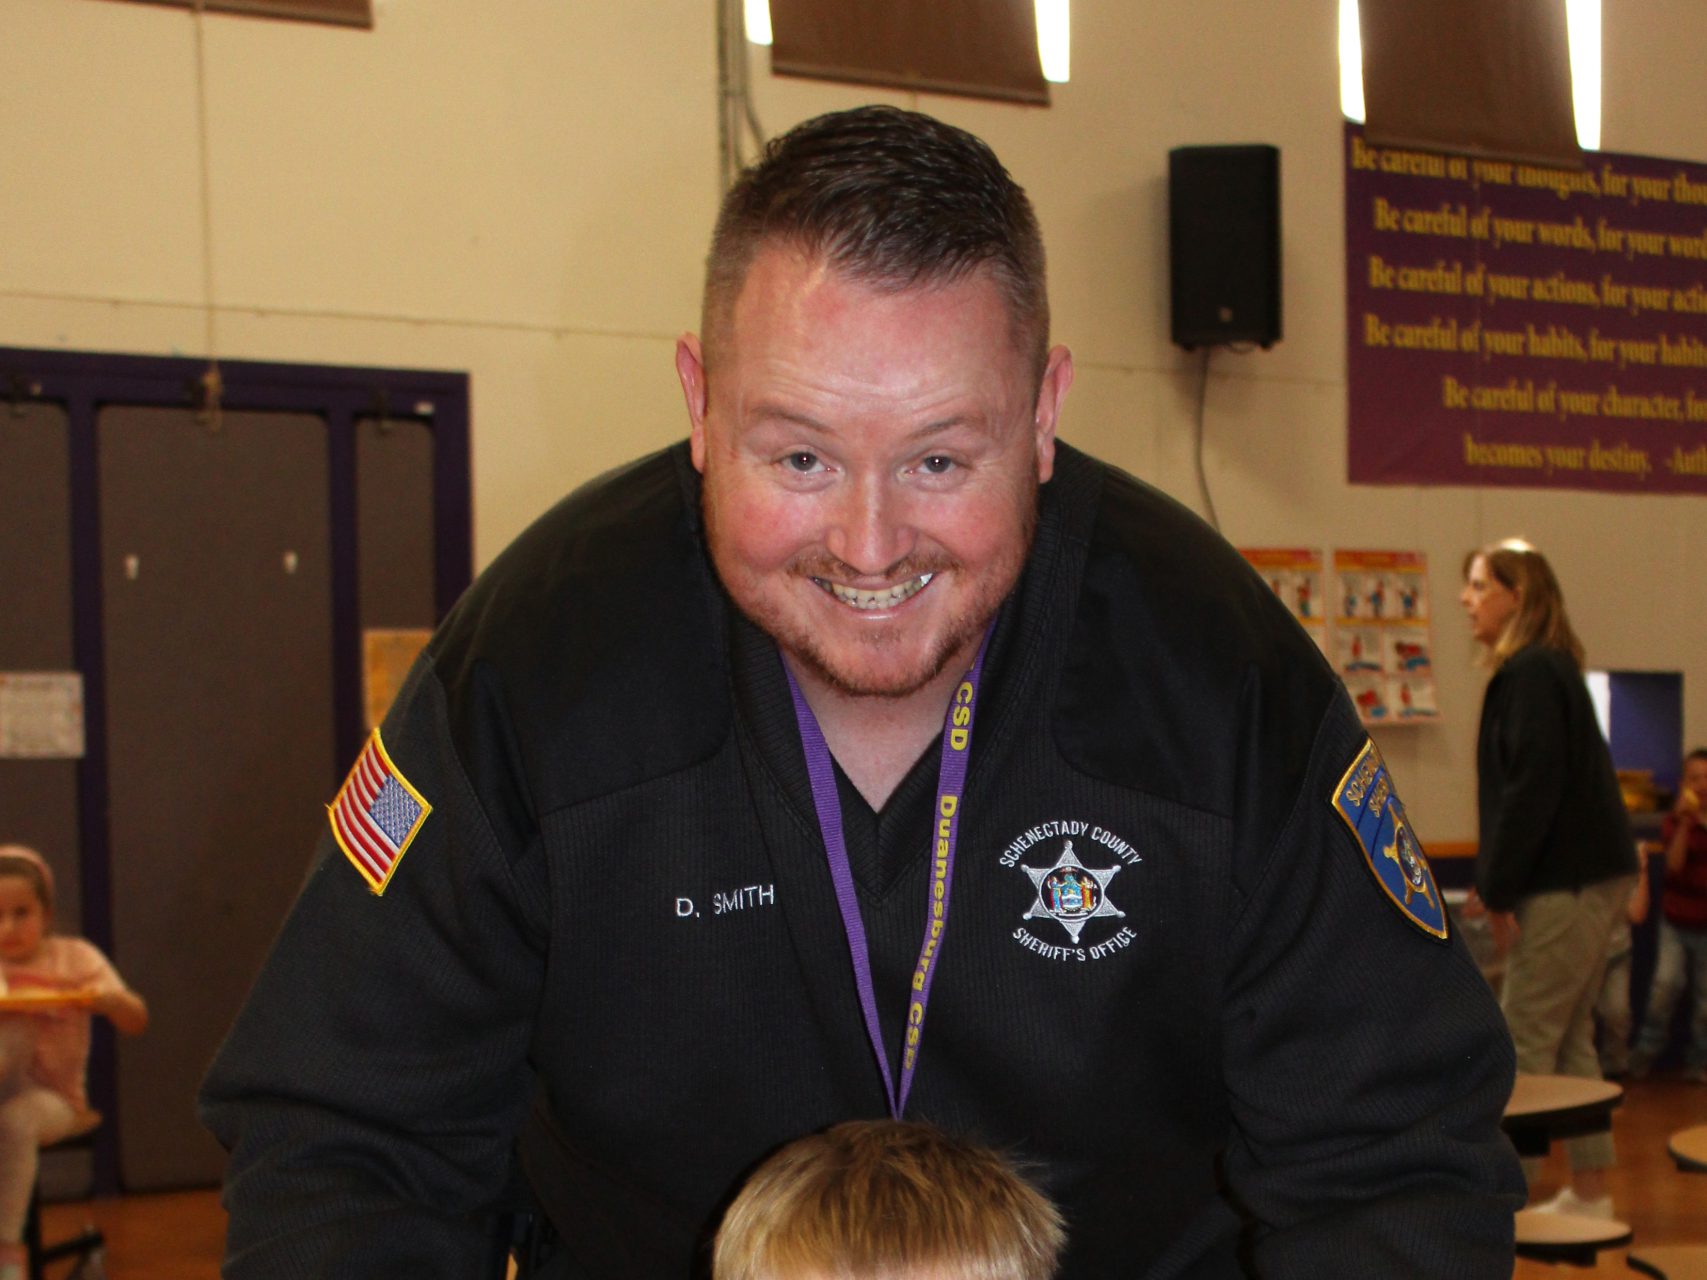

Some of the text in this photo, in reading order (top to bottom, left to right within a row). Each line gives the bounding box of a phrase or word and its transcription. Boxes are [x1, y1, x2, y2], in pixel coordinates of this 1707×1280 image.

[1352, 137, 1376, 170] Be
[1472, 160, 1512, 190] your
[1602, 163, 1627, 197] for
[1632, 176, 1669, 206] your
[1374, 197, 1399, 231] Be
[1403, 203, 1467, 237] careful
[1470, 206, 1491, 239] of
[1492, 218, 1534, 249] your
[1538, 216, 1596, 253] words,
[1598, 218, 1622, 252] for
[1627, 229, 1664, 261] your
[1369, 255, 1394, 289] Be
[1399, 260, 1462, 295] careful
[1465, 263, 1486, 297] of
[1487, 273, 1529, 306] your
[1532, 271, 1600, 309] actions,
[1603, 275, 1627, 308] for
[1632, 286, 1669, 317] your
[1364, 313, 1390, 347] Be
[1393, 316, 1457, 351] careful
[1461, 319, 1481, 352] of
[1484, 328, 1525, 364] your
[1527, 323, 1588, 364] habits,
[1590, 328, 1614, 362] for
[1618, 339, 1657, 371] your
[1444, 375, 1469, 409] Be
[1472, 377, 1534, 412] careful
[1537, 379, 1556, 412] of
[1558, 390, 1600, 423] your
[1603, 384, 1685, 423] character,
[1464, 433, 1544, 468] becomes
[1546, 445, 1585, 478] your
[950, 681, 973, 751] CSD
[1000, 820, 1143, 868] SCHENECTADY COUNTY
[676, 883, 774, 918] D. SMITH
[912, 794, 959, 992] Duanesburg
[1012, 926, 1137, 962] SHERIFF'S OFFICE
